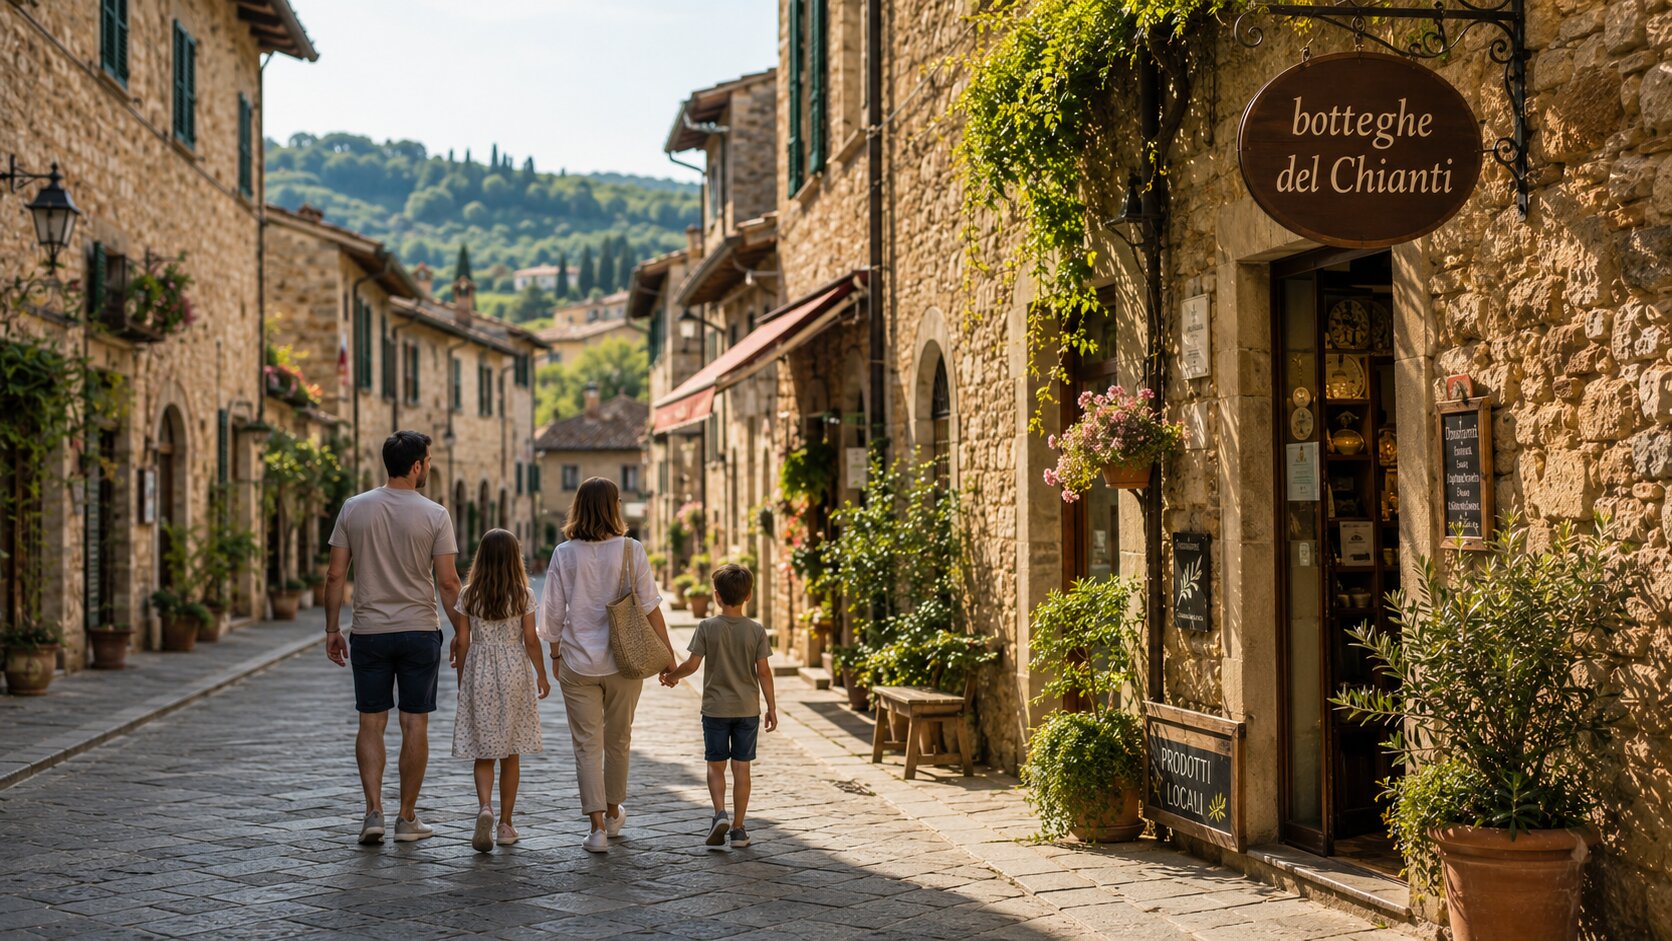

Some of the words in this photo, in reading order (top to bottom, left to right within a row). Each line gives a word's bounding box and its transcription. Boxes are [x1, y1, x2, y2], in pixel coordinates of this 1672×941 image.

[1292, 96, 1433, 150] botteghe
[1276, 154, 1319, 193] del
[1330, 155, 1453, 194] Chianti
[1161, 747, 1211, 785] PRODOTTI
[1166, 782, 1203, 815] LOCALI
